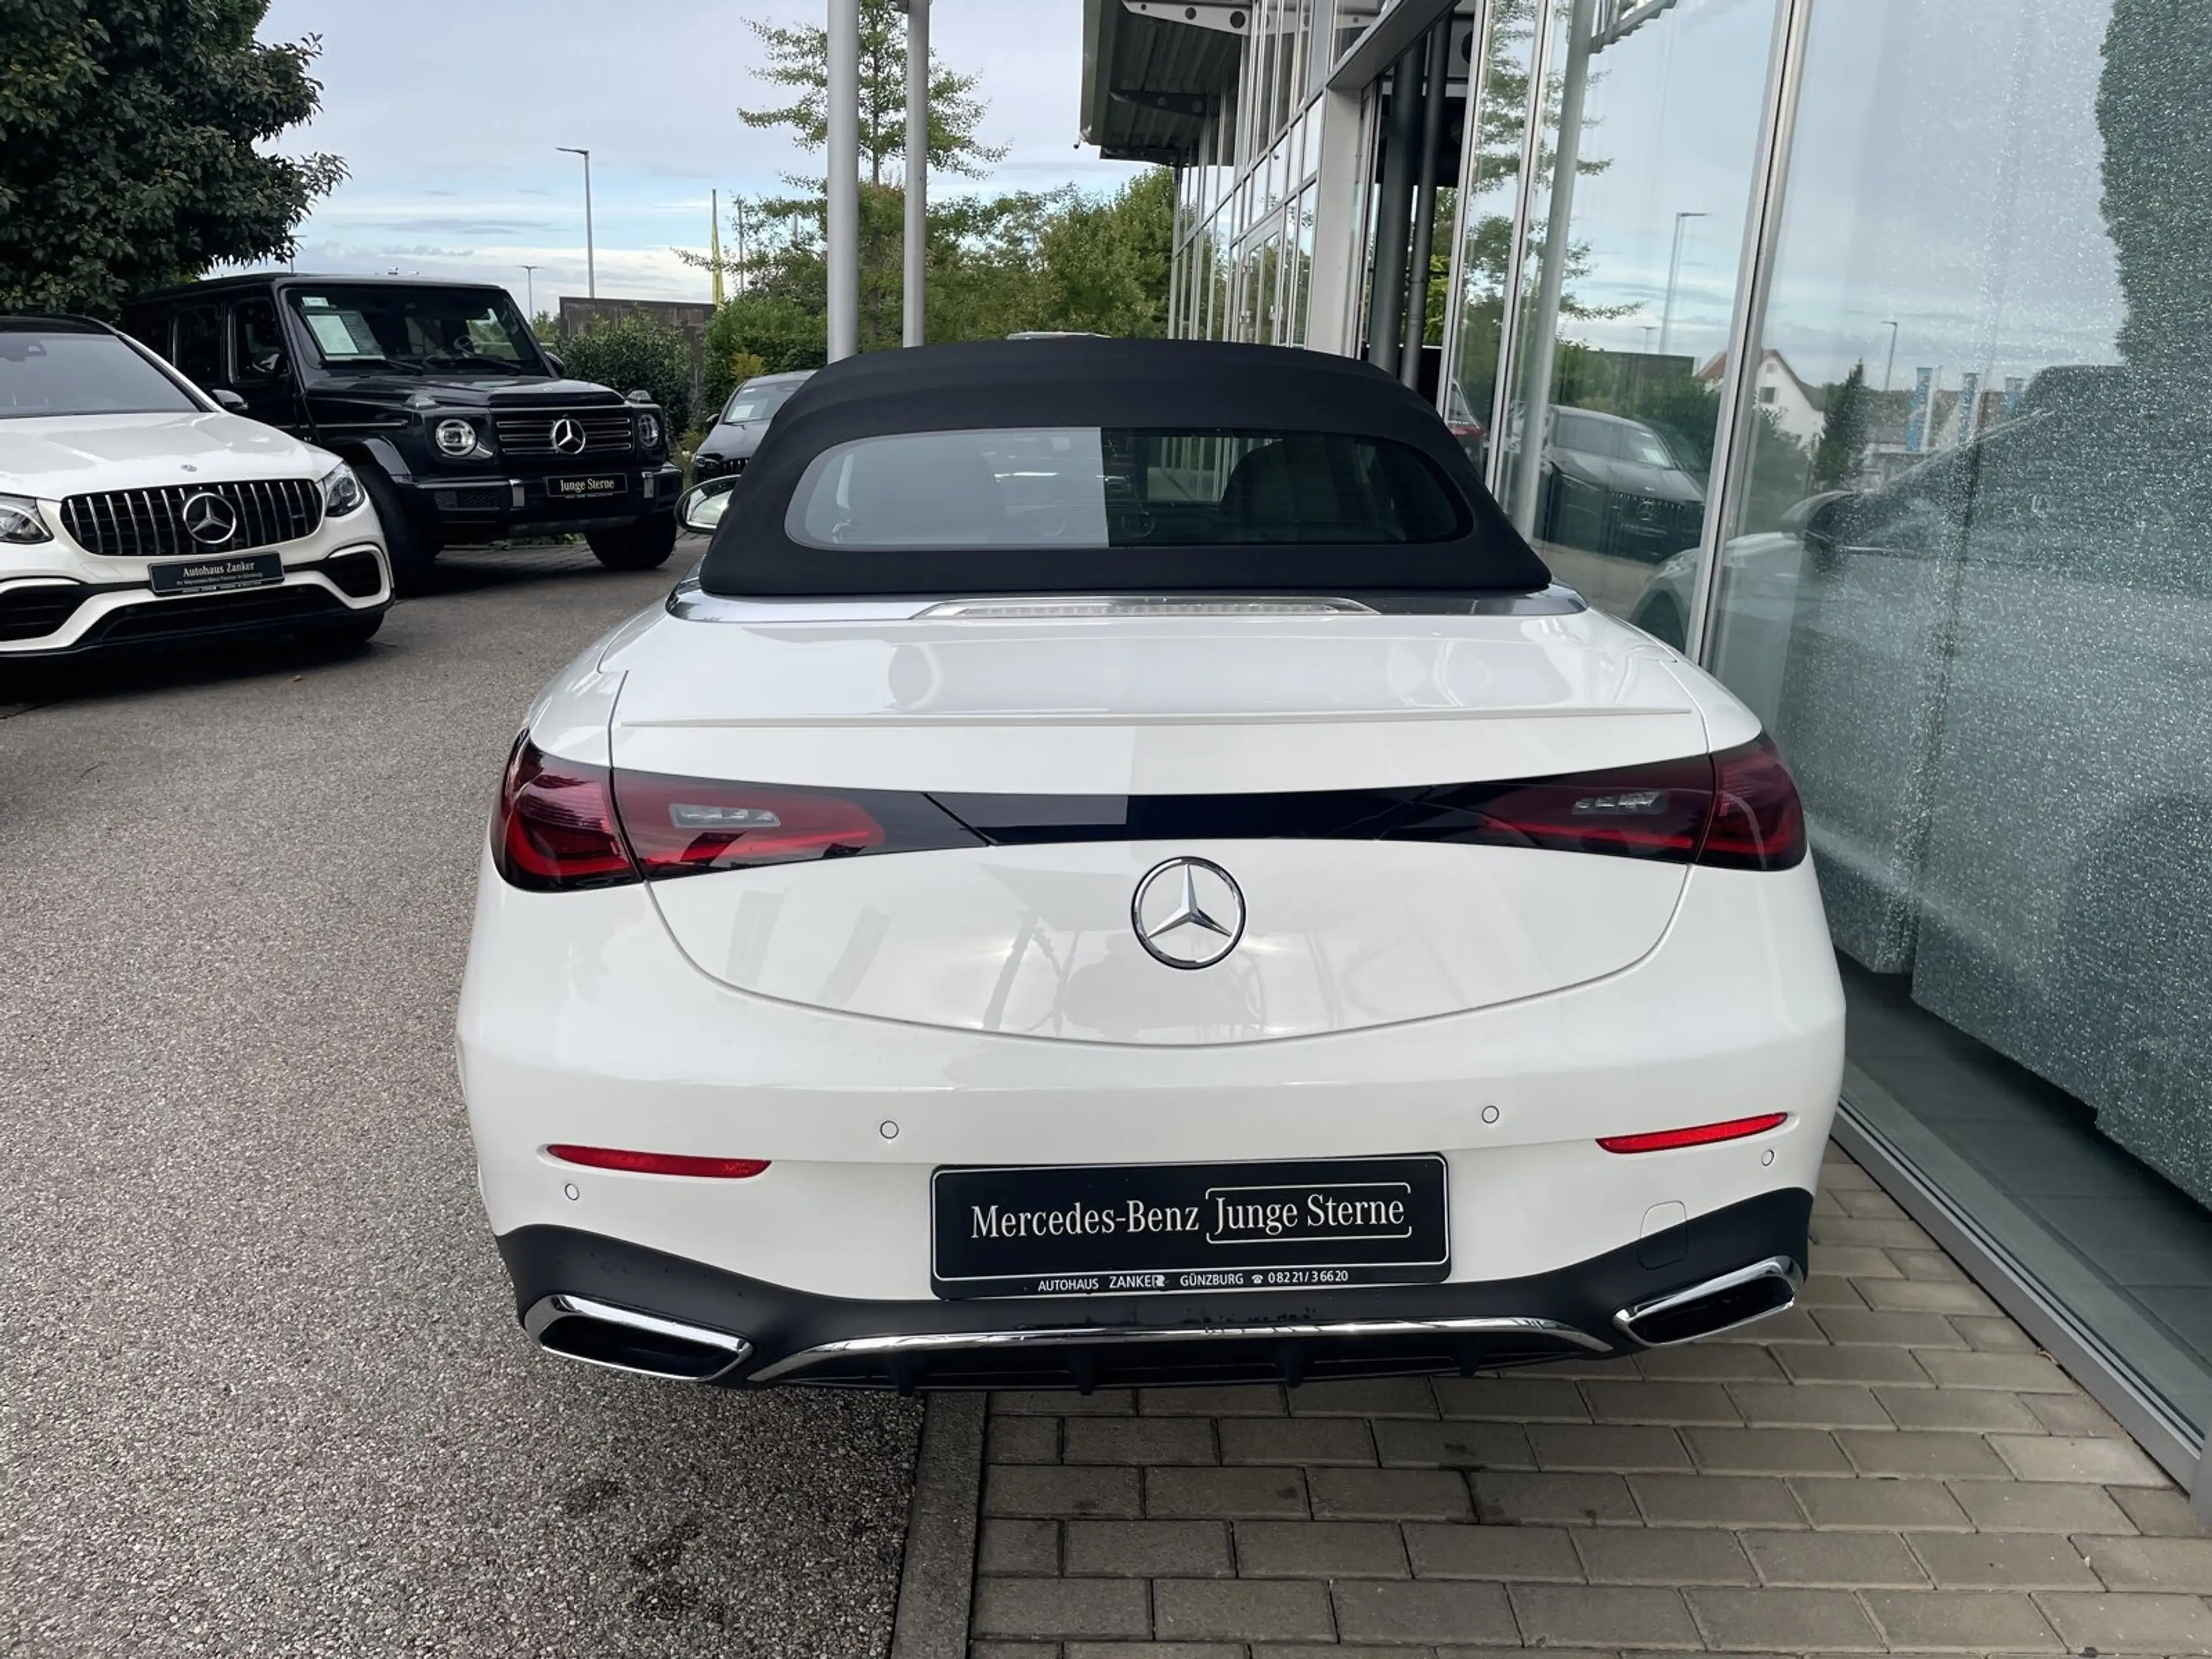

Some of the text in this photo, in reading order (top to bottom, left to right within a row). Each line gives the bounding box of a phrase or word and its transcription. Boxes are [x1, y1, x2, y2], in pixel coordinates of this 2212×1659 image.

[560, 478, 615, 493] Junge Sterne
[183, 561, 255, 577] Autohaus Zanker
[971, 1194, 1404, 1238] Mercedes-Benz Junge Sterne
[1037, 1278, 1099, 1292] AUTOHAUS
[1108, 1274, 1165, 1289] ZANKER
[1180, 1272, 1244, 1287] GÜNZBURG
